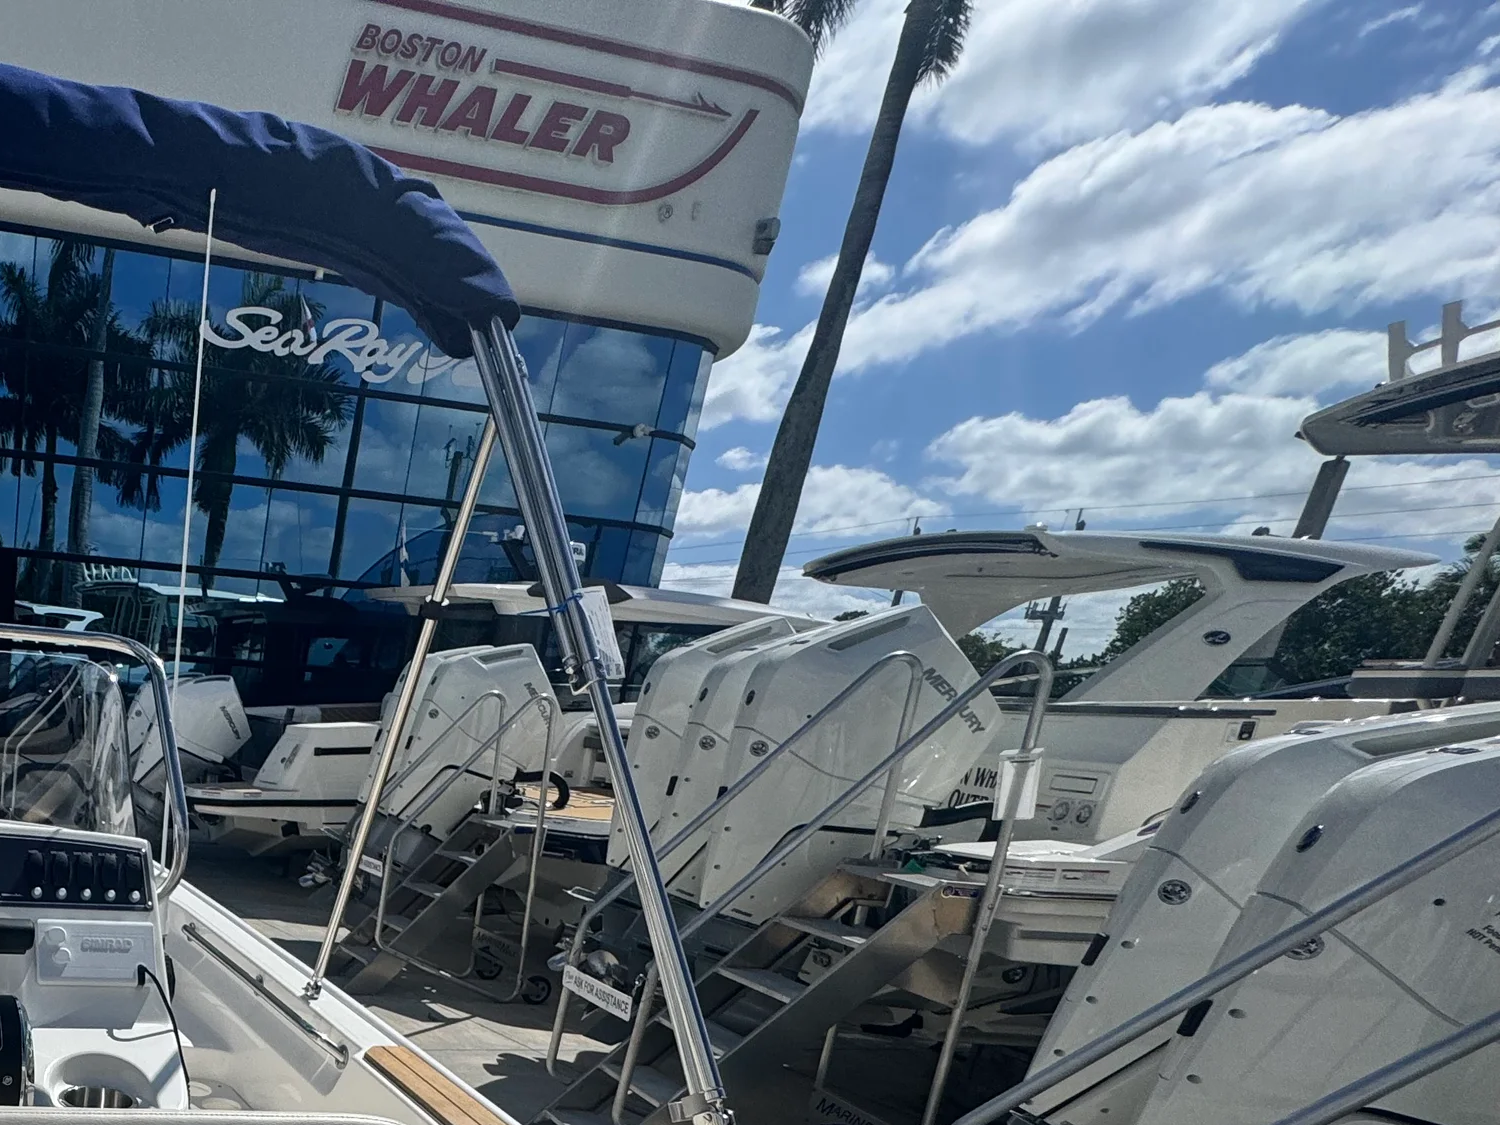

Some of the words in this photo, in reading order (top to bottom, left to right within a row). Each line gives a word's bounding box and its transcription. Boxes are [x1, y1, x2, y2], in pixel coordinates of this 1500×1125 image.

[355, 23, 488, 73] BOSTON
[335, 58, 631, 164] WHALER
[199, 306, 318, 357] Sea
[308, 318, 424, 384] Ray
[922, 667, 986, 734] MERURY
